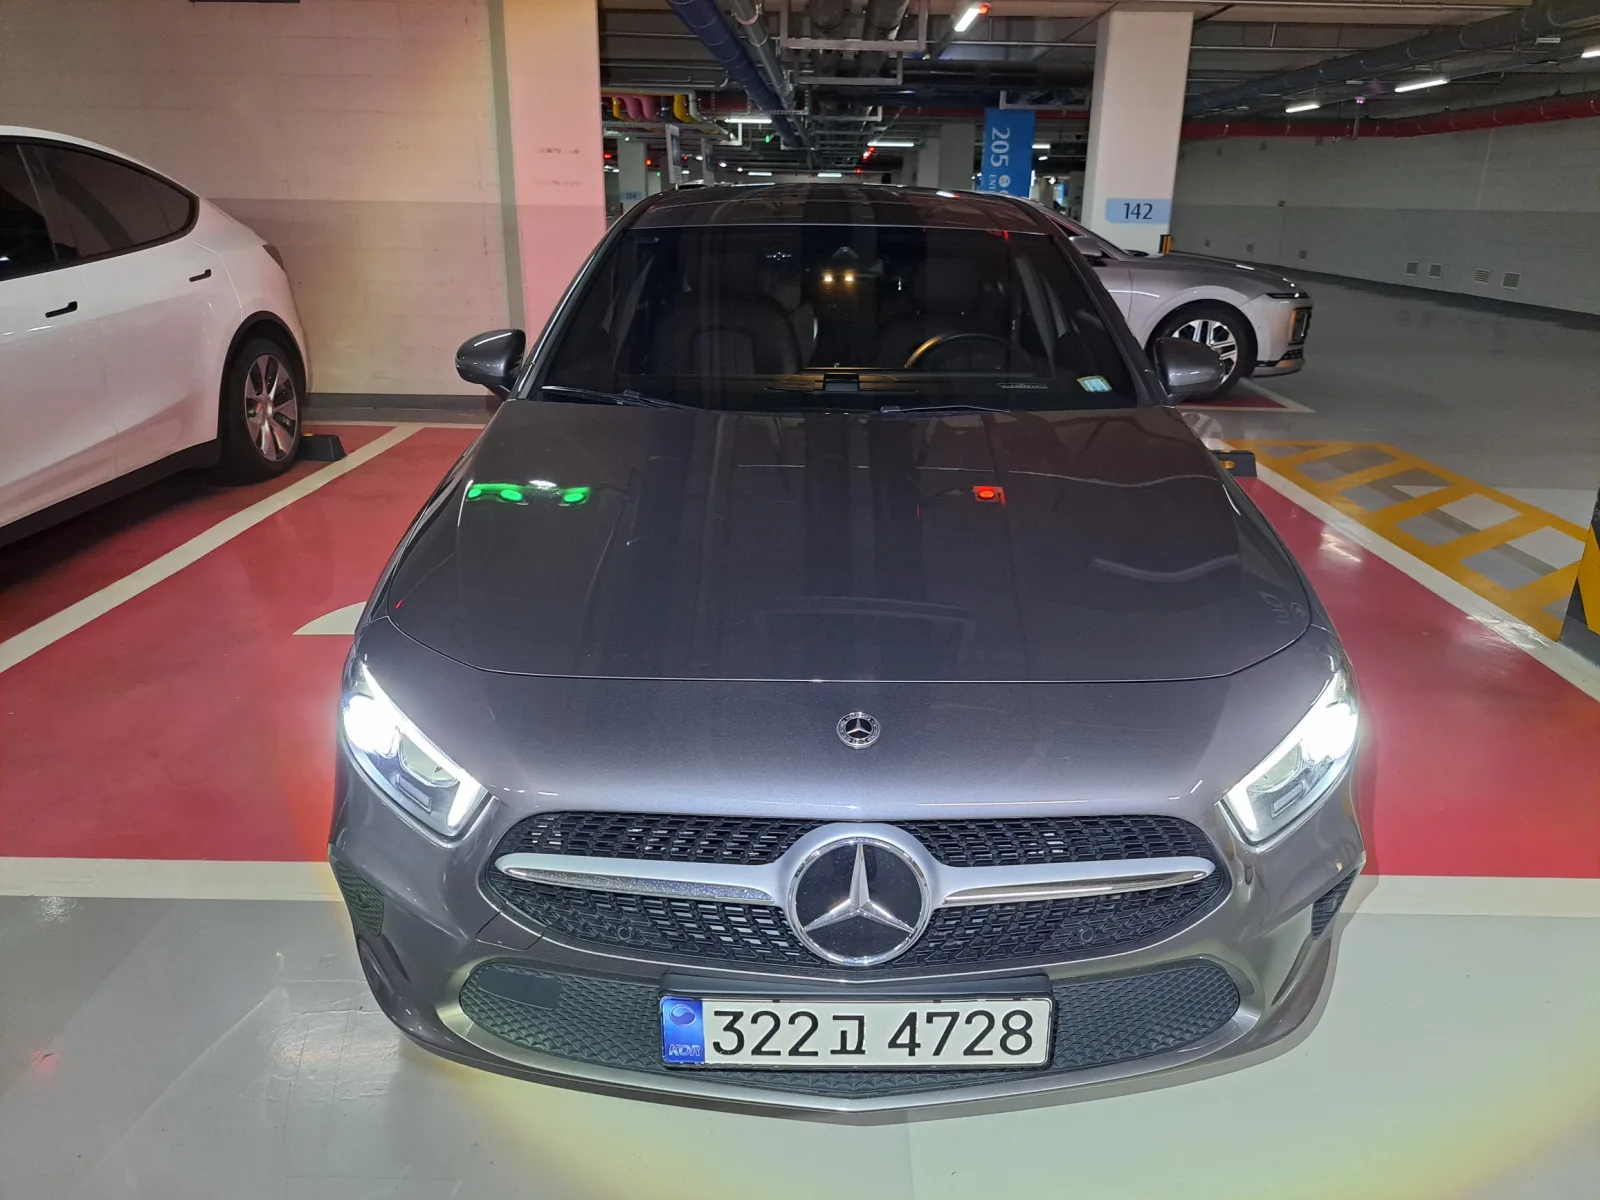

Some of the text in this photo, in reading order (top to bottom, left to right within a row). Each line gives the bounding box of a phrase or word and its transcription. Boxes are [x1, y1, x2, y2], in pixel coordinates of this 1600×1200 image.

[990, 127, 1011, 168] 205
[1123, 202, 1153, 220] 142
[712, 1009, 1034, 1057] 322고 4728
[668, 1043, 701, 1057] KOR
